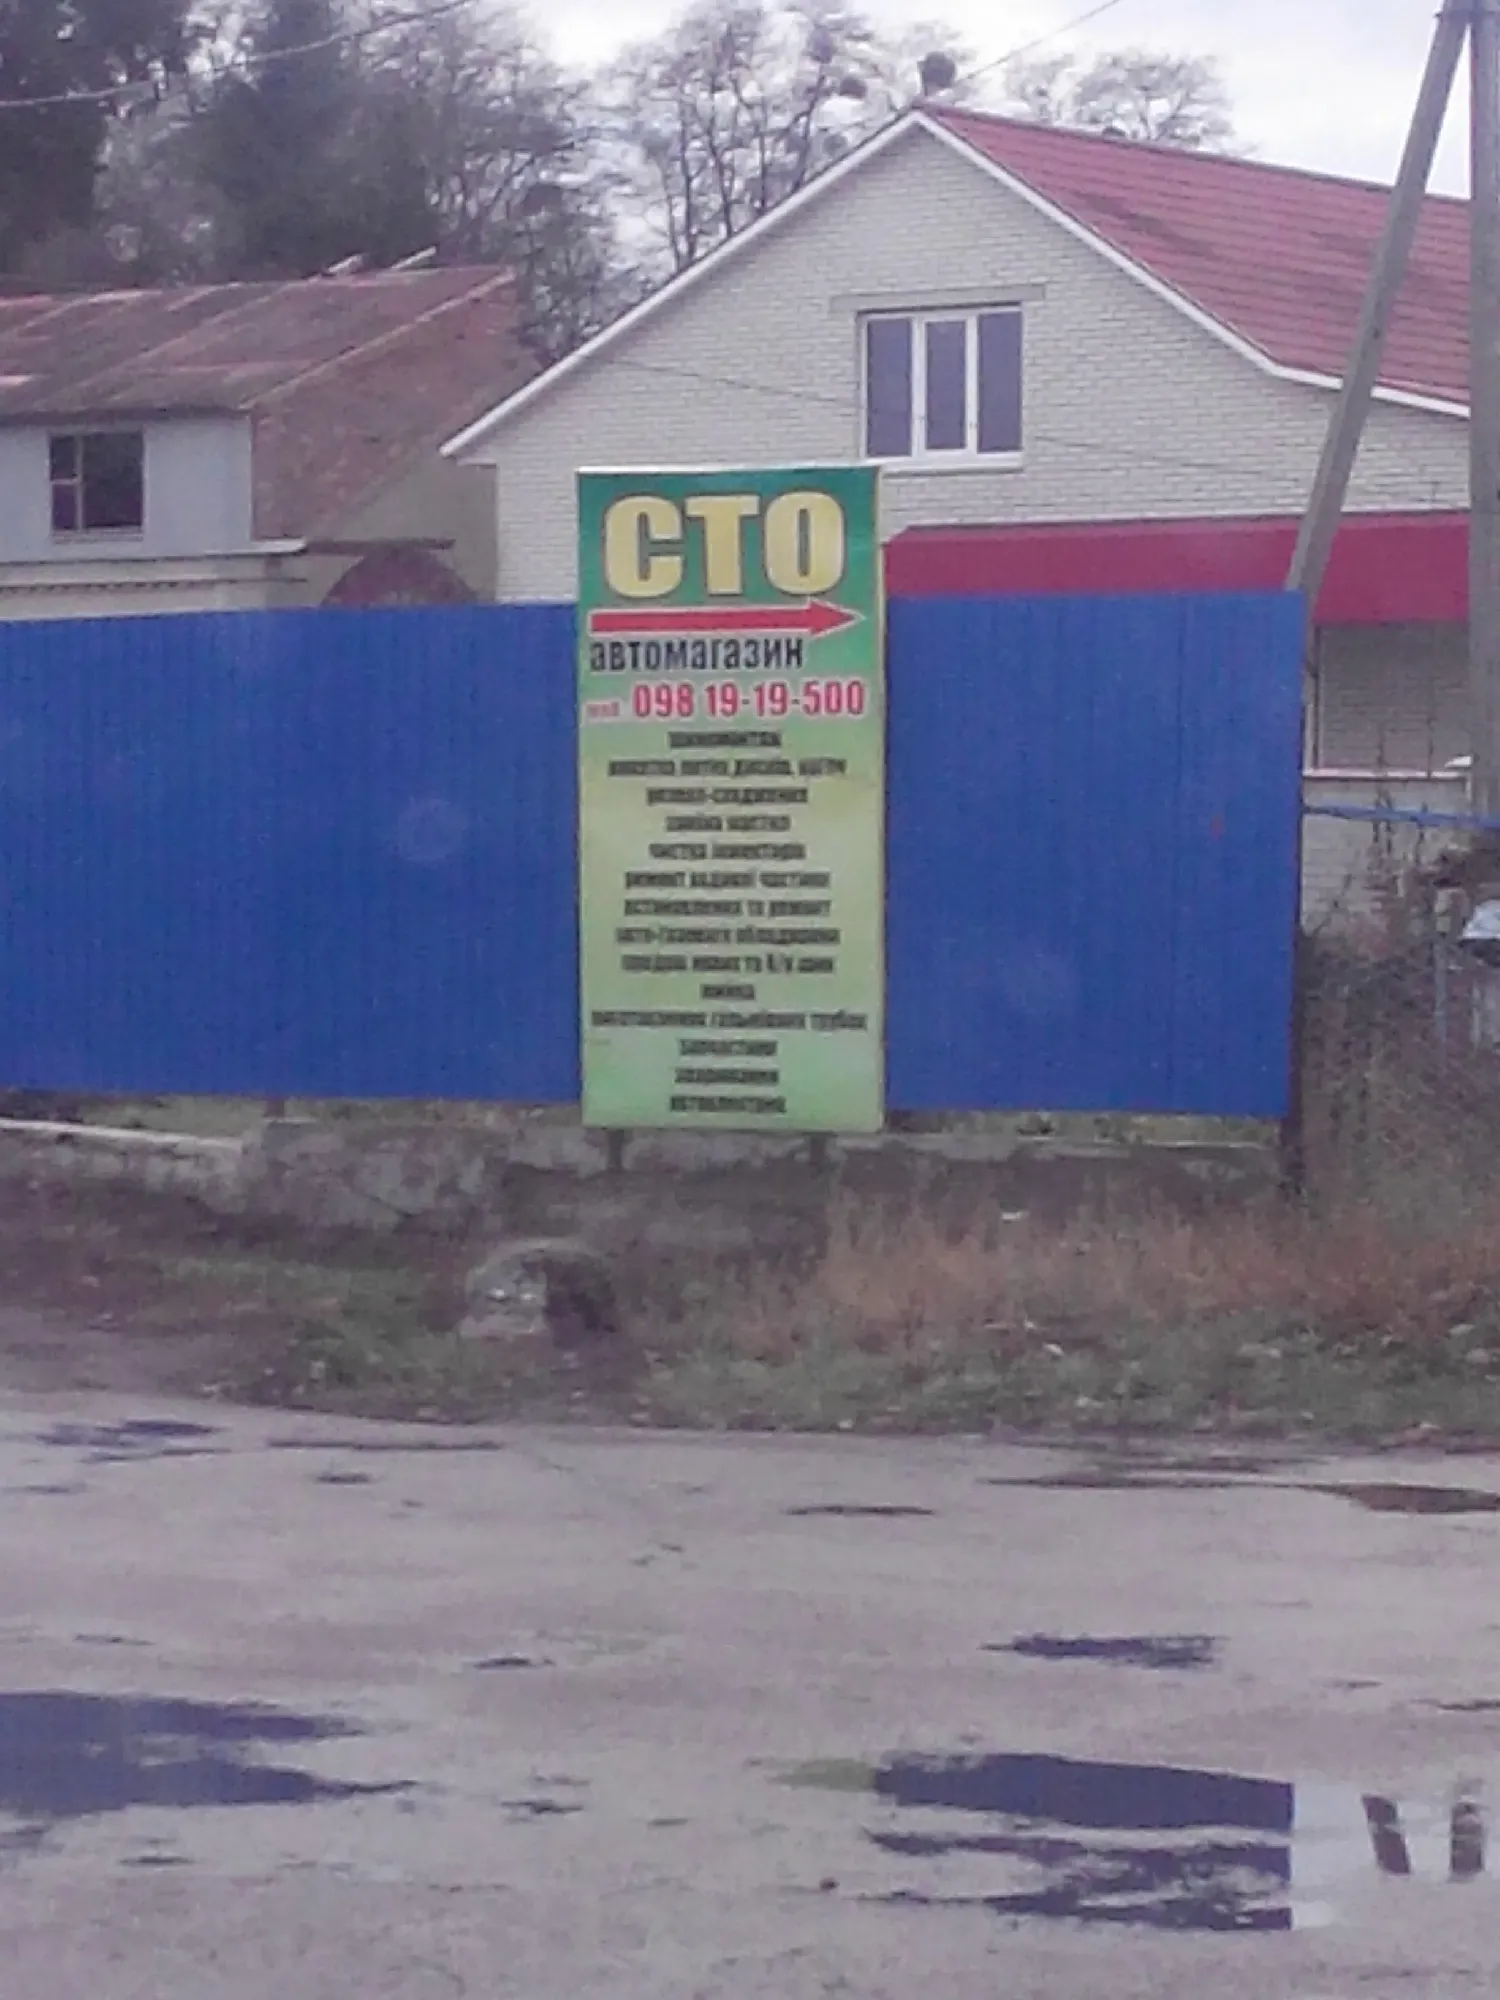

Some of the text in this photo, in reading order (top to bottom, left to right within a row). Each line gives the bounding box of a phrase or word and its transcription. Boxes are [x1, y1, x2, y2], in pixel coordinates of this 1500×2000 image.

[605, 491, 845, 598] СТО
[589, 638, 803, 671] автомагазин
[632, 683, 694, 717] 098
[703, 680, 865, 716] 19-19-500
